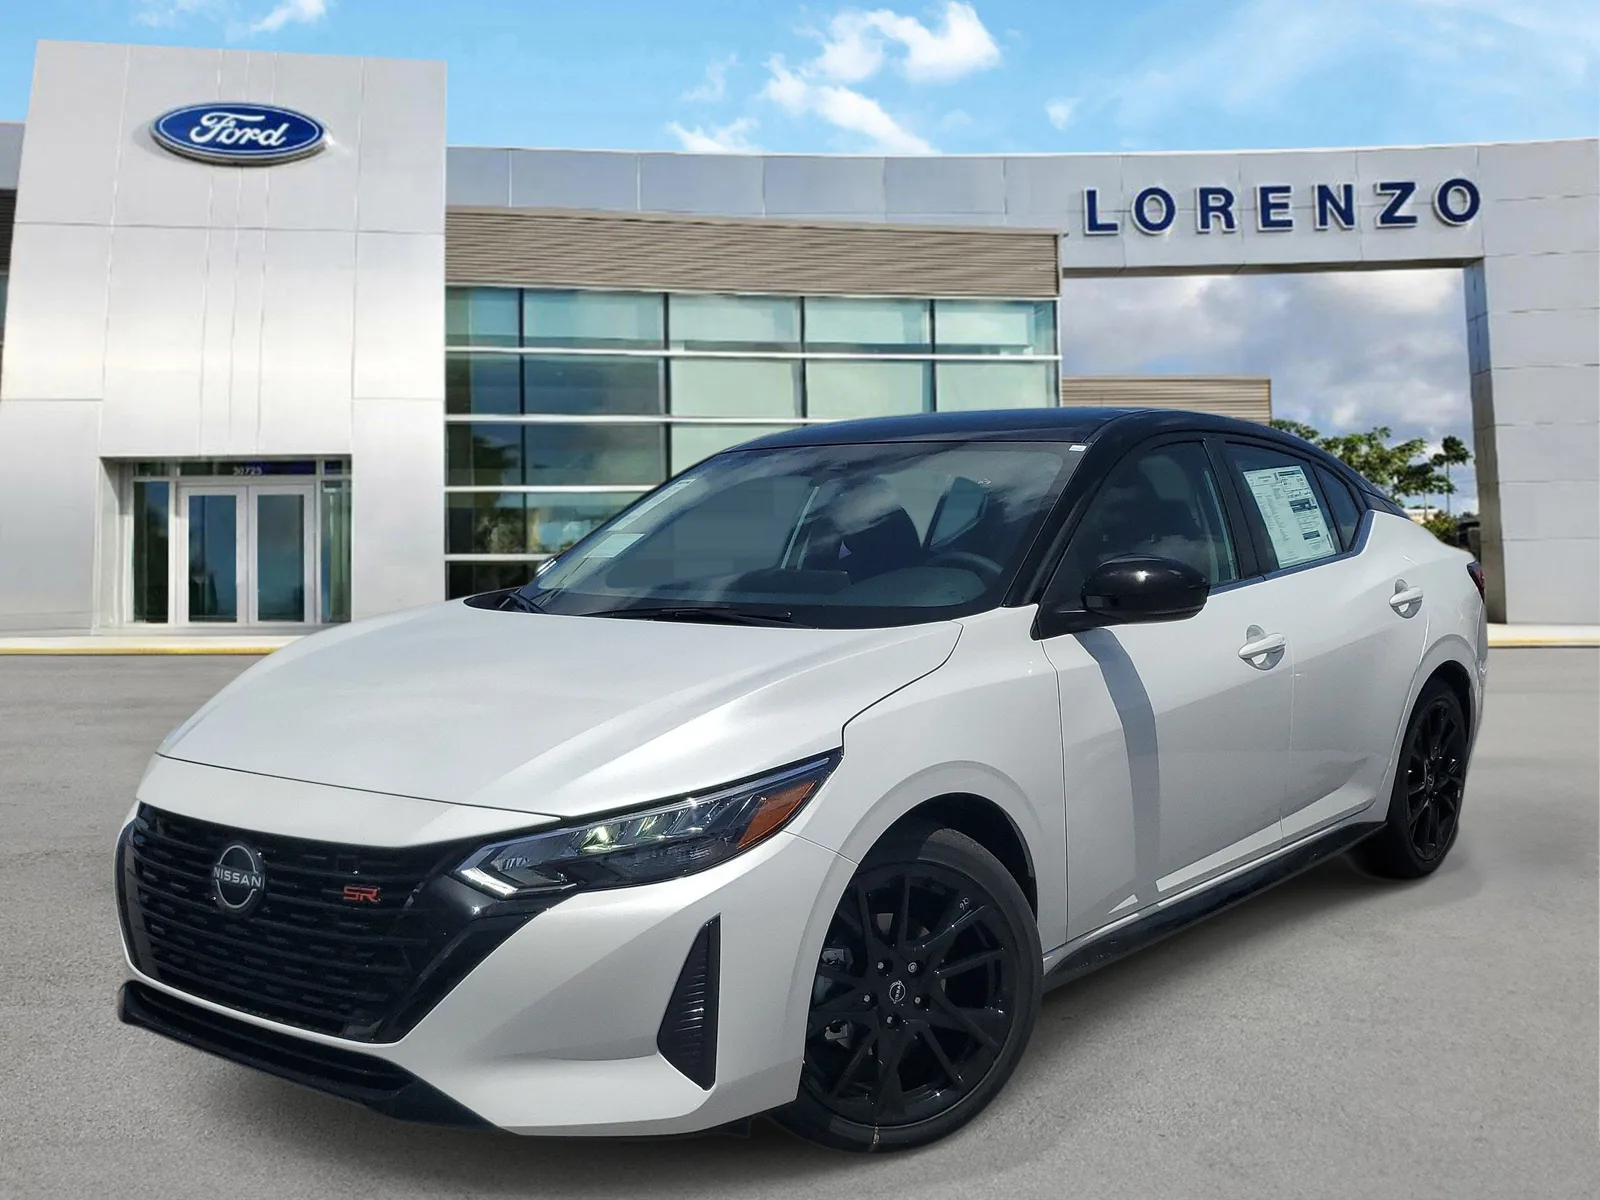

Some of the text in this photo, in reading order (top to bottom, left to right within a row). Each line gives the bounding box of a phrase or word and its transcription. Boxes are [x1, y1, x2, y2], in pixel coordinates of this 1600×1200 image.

[190, 112, 290, 146] Ford
[1083, 178, 1480, 234] LORENZO
[213, 866, 262, 887] NISSAN
[343, 885, 378, 903] SR
